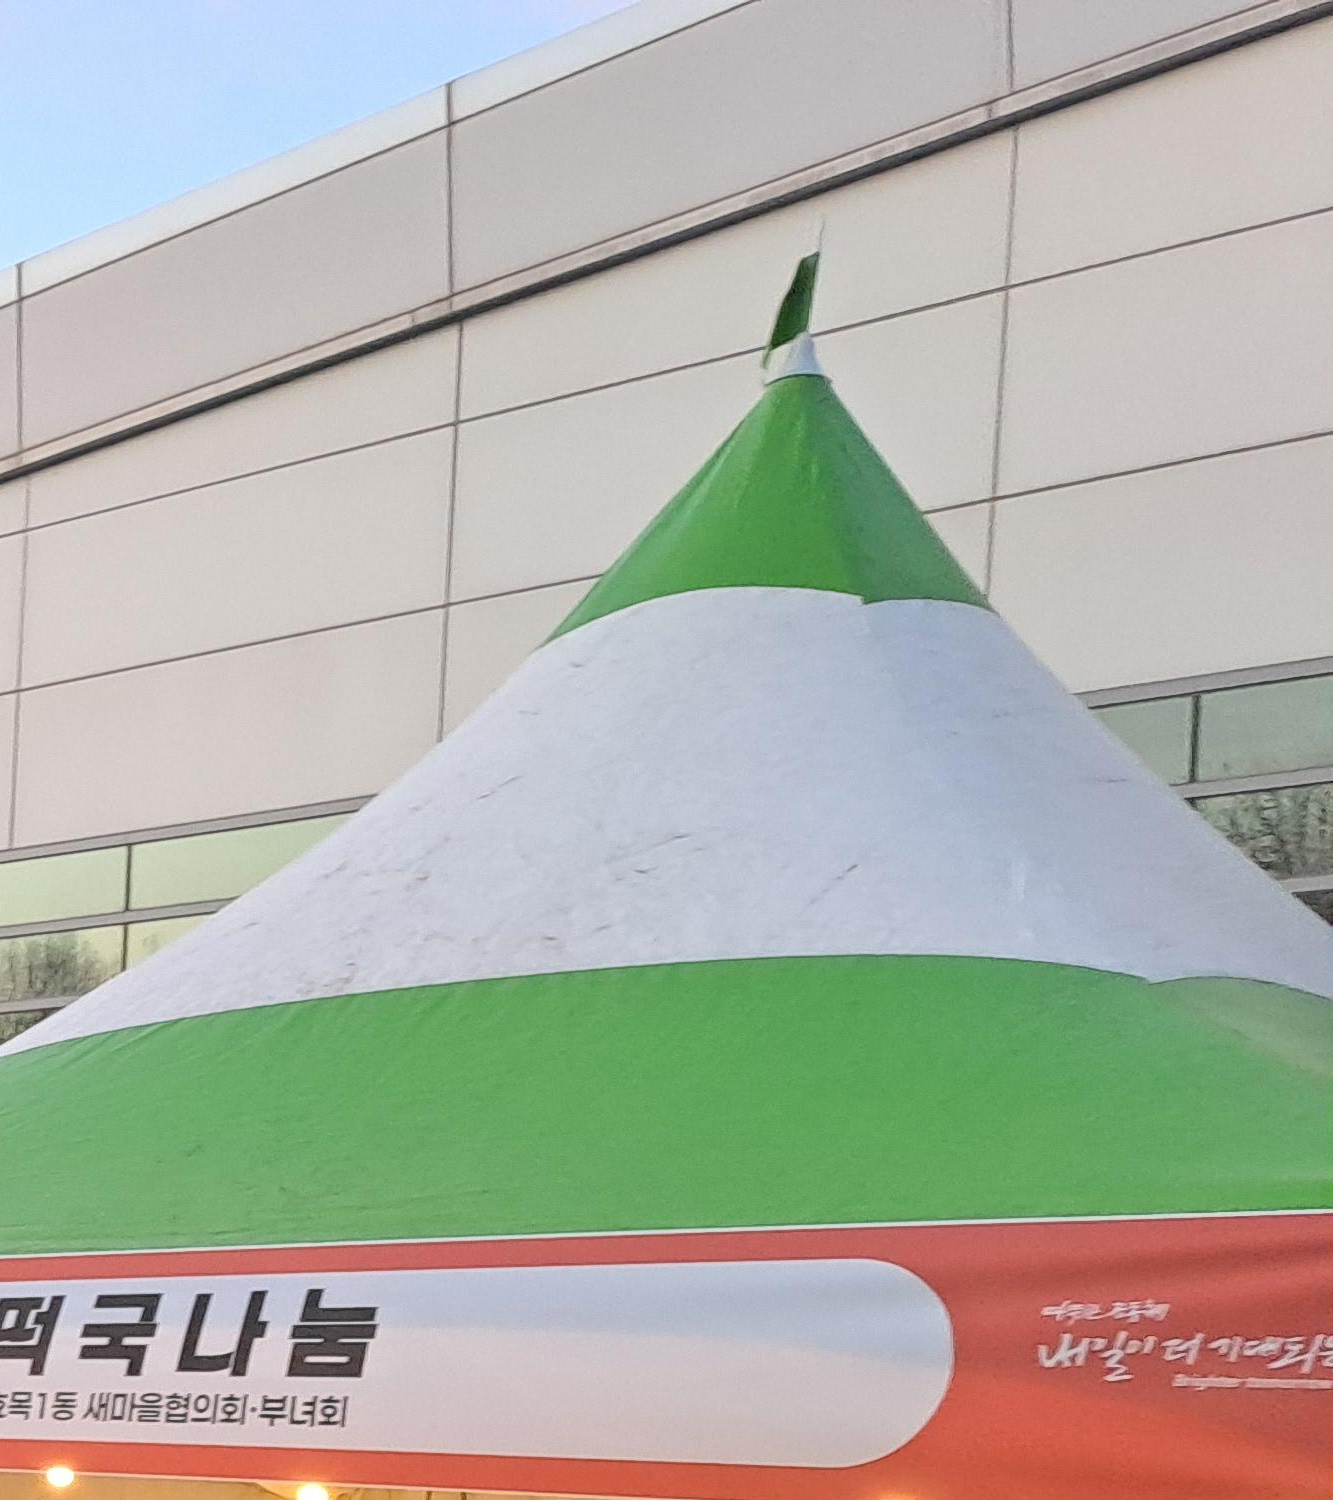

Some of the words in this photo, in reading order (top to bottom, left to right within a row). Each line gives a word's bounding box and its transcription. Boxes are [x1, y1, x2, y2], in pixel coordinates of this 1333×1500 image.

[1037, 1330, 1158, 1382] 내일이
[1161, 1332, 1205, 1366] 더
[82, 1390, 349, 1428] 새마을협의회·부녀회
